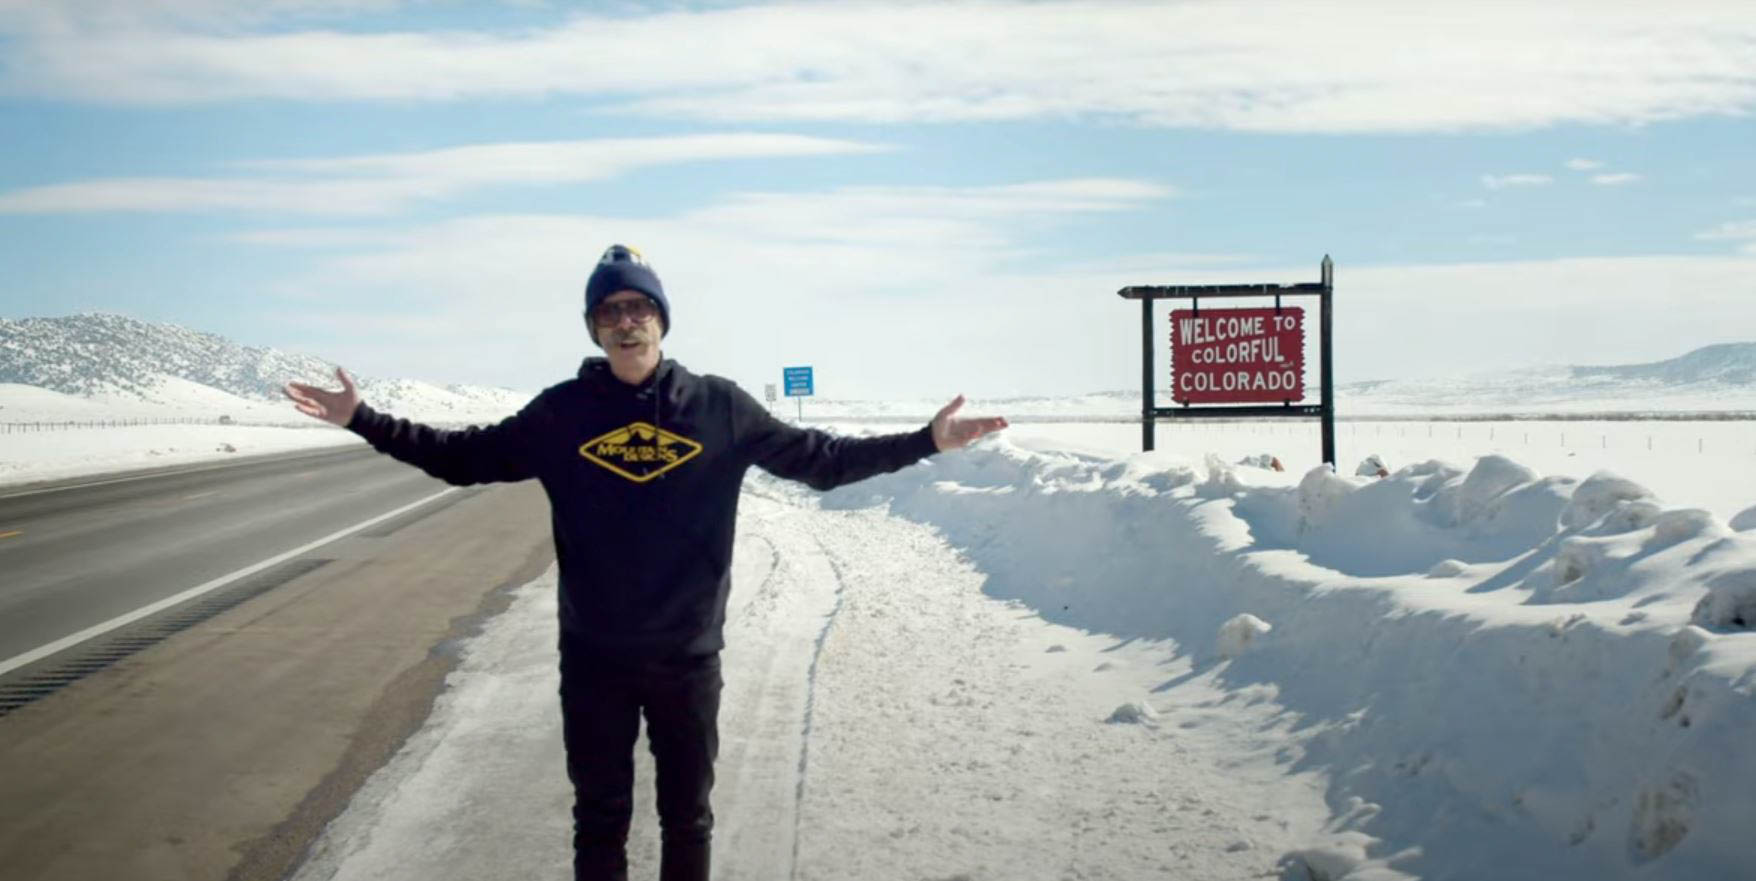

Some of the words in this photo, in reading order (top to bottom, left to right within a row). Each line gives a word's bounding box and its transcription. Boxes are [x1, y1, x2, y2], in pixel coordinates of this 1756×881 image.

[1179, 316, 1265, 346] WELCOME
[1273, 316, 1296, 332] TO
[1191, 336, 1285, 363] COLORFUL
[1180, 370, 1296, 391] COLORADO
